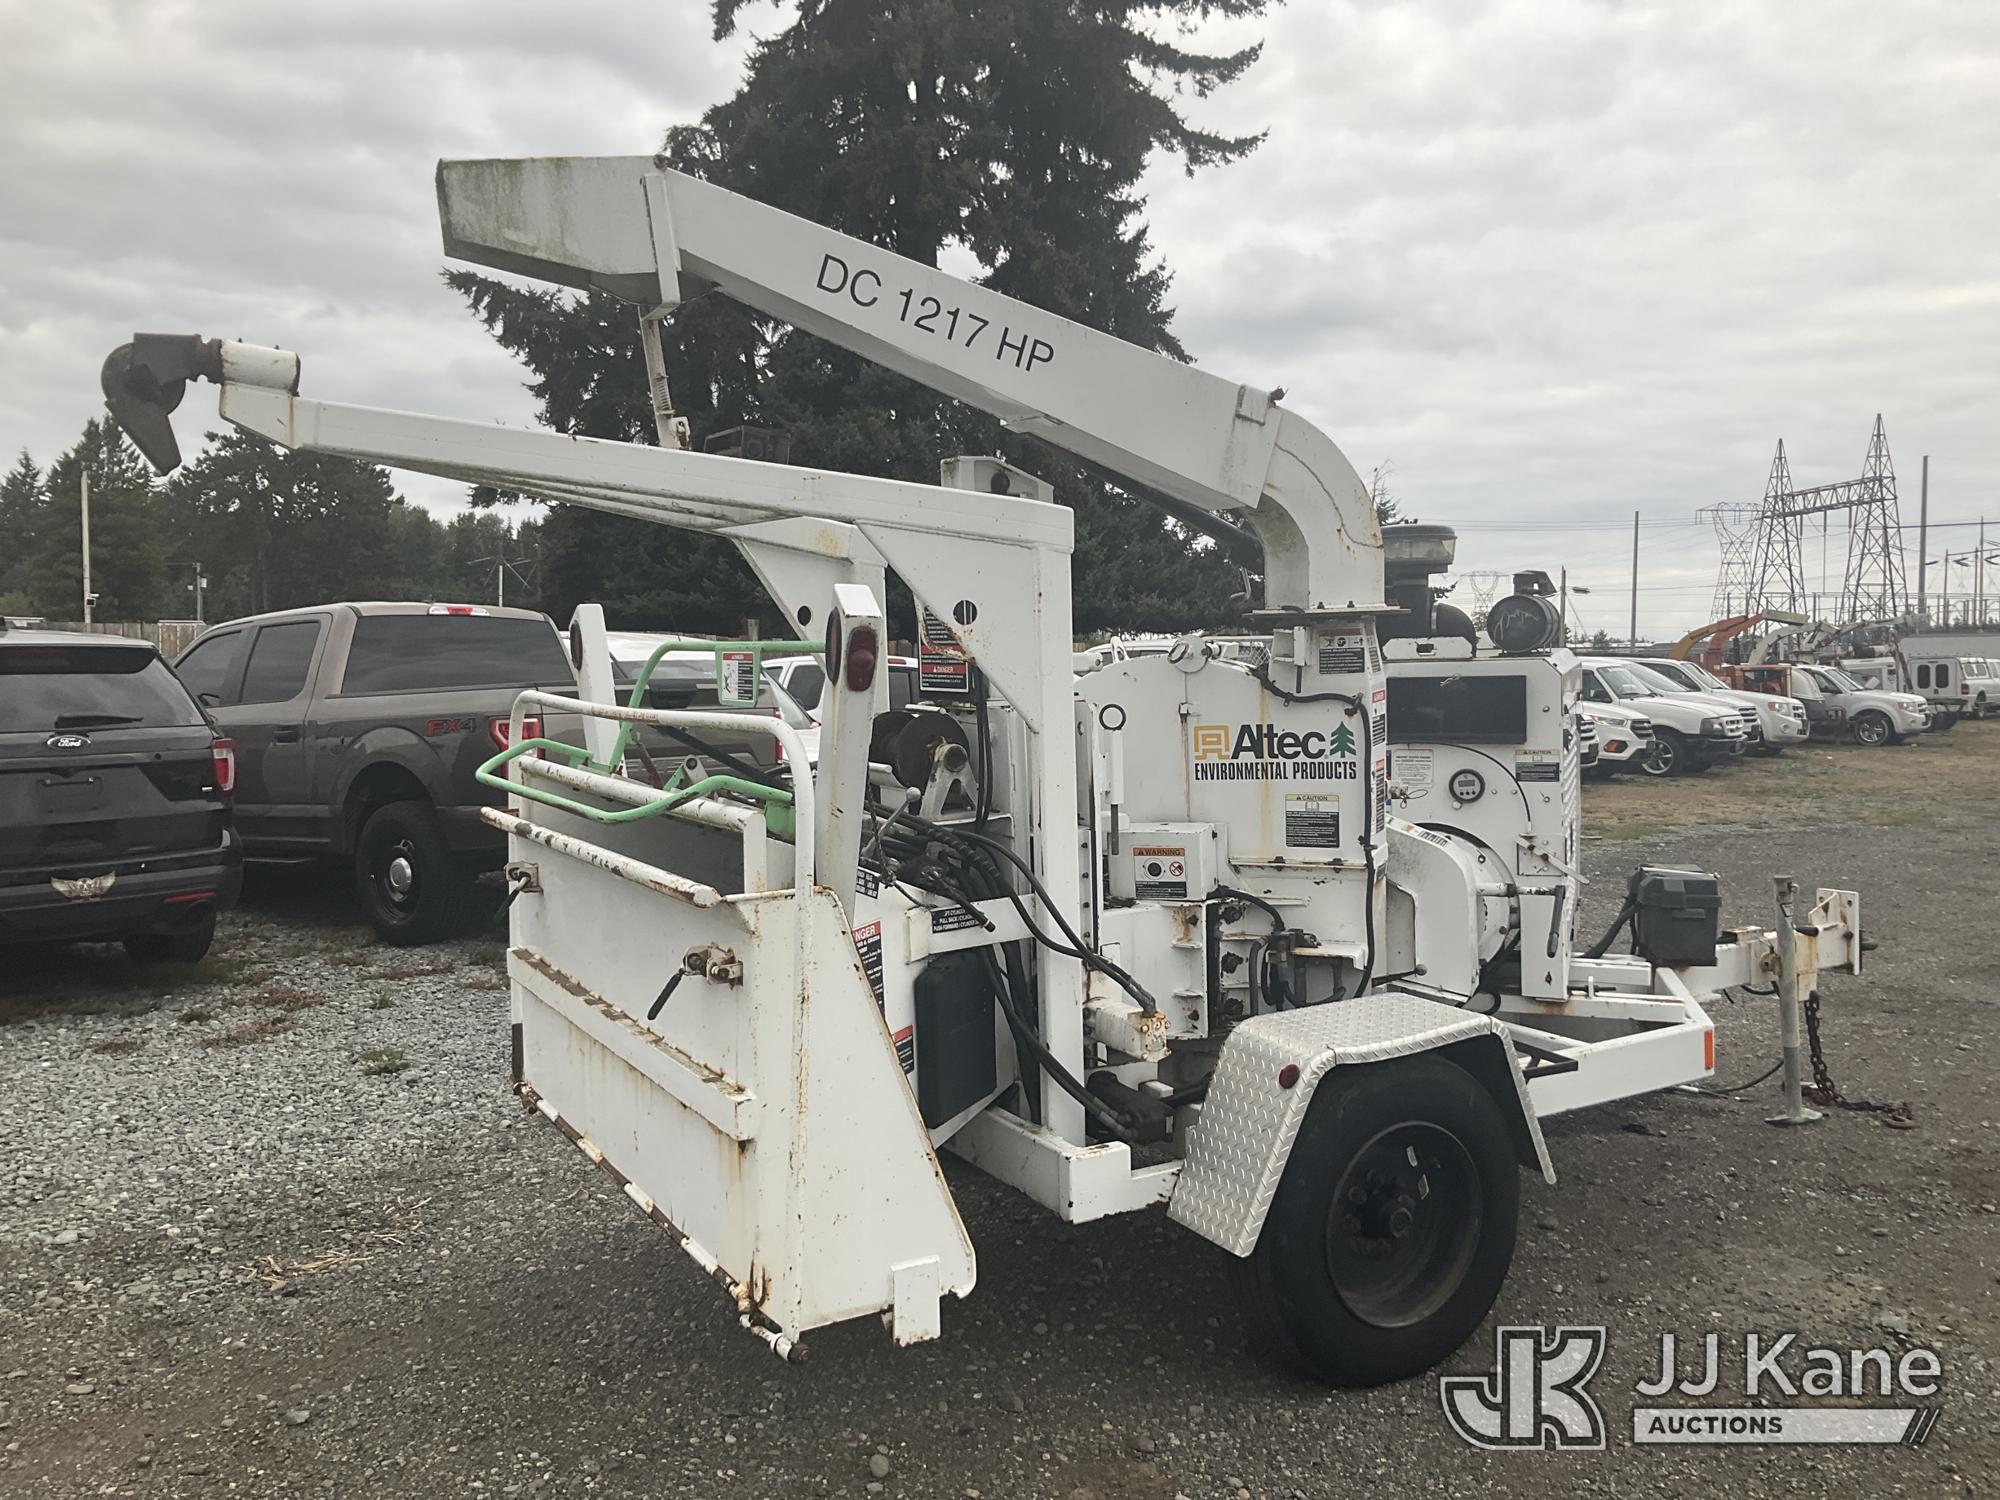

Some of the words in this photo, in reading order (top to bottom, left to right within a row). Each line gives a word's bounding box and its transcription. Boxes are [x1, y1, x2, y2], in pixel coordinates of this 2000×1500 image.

[816, 253, 882, 308] DC
[898, 287, 990, 348] 1217
[995, 326, 1055, 372] HP
[427, 717, 477, 737] FX4
[57, 737, 82, 747] Ford
[1231, 724, 1326, 760] Altec
[1195, 762, 1289, 781] ENVIRONMENTAL
[1293, 761, 1357, 780] PRODUCTS
[1145, 848, 1181, 856] WARNING
[854, 925, 876, 942] NGER
